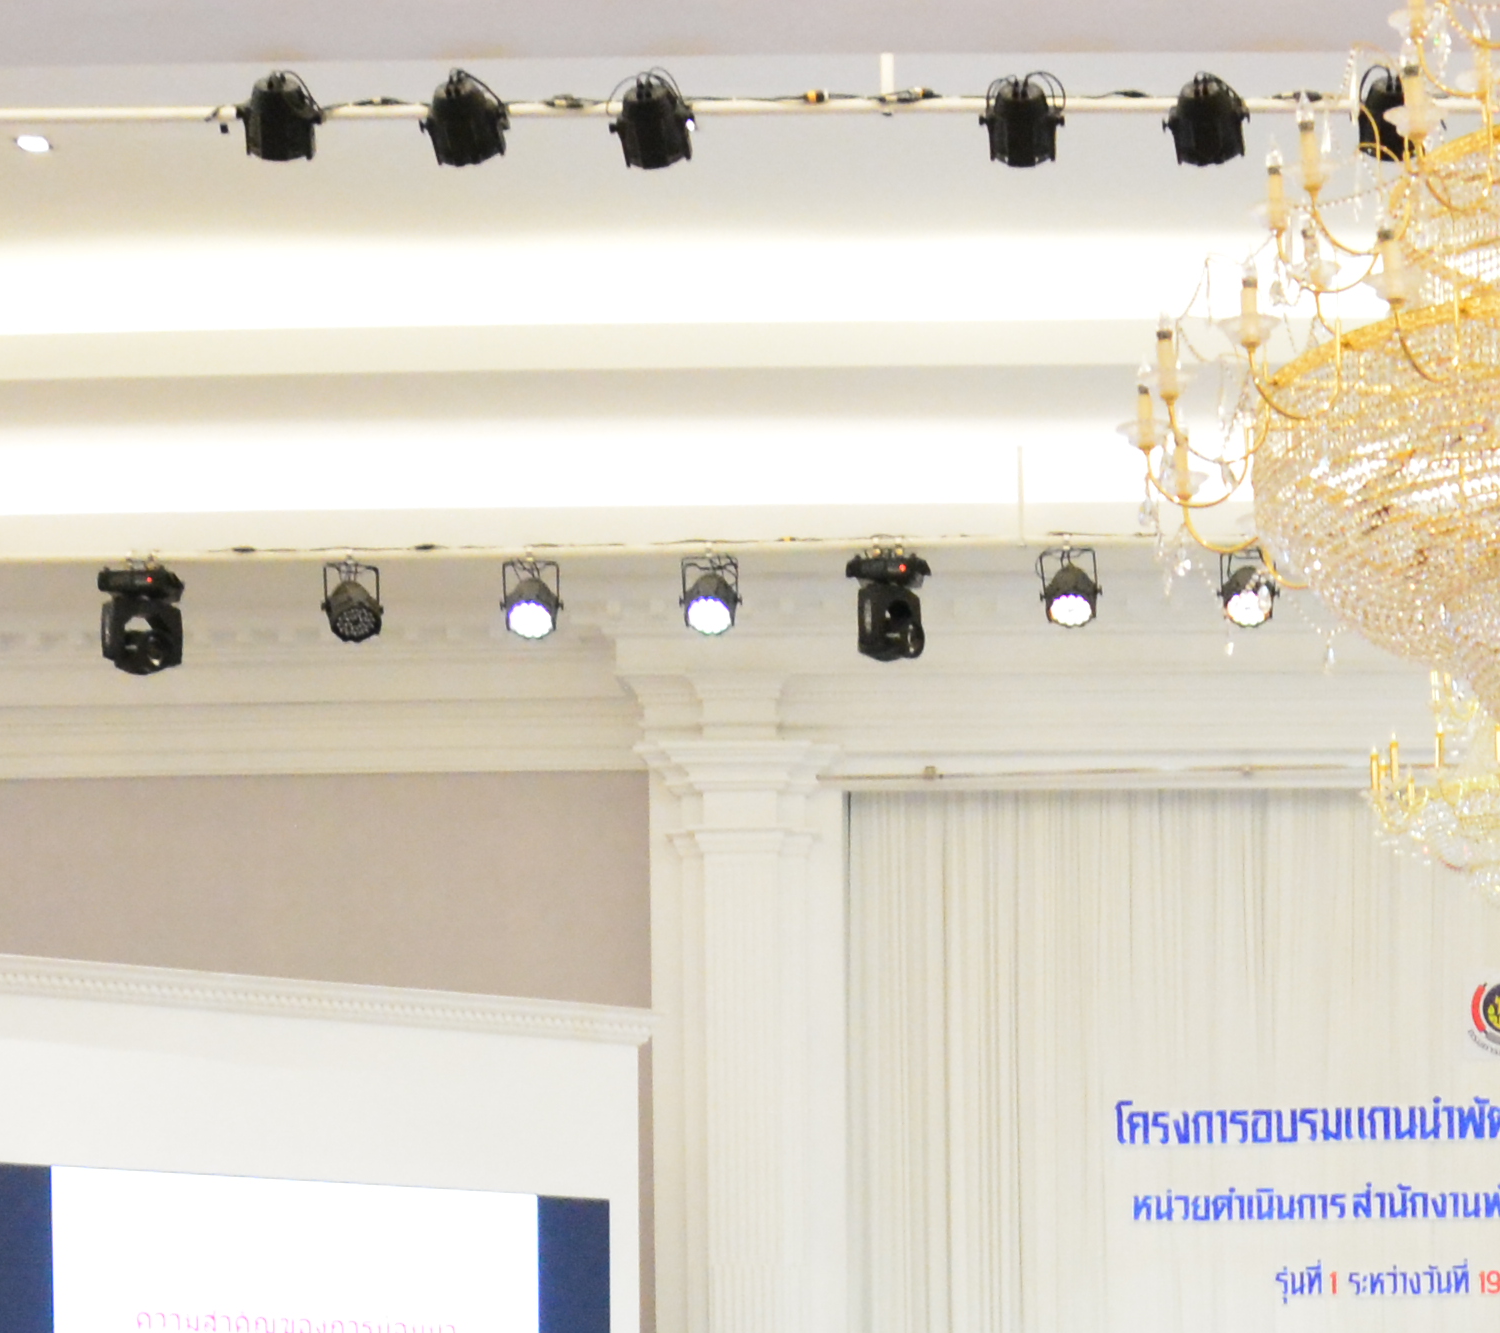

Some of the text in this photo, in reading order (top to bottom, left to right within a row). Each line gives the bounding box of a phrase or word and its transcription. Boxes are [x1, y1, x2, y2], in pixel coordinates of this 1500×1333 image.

[1275, 1260, 1323, 1304] รุ่นที่
[1329, 1271, 1338, 1295] 1
